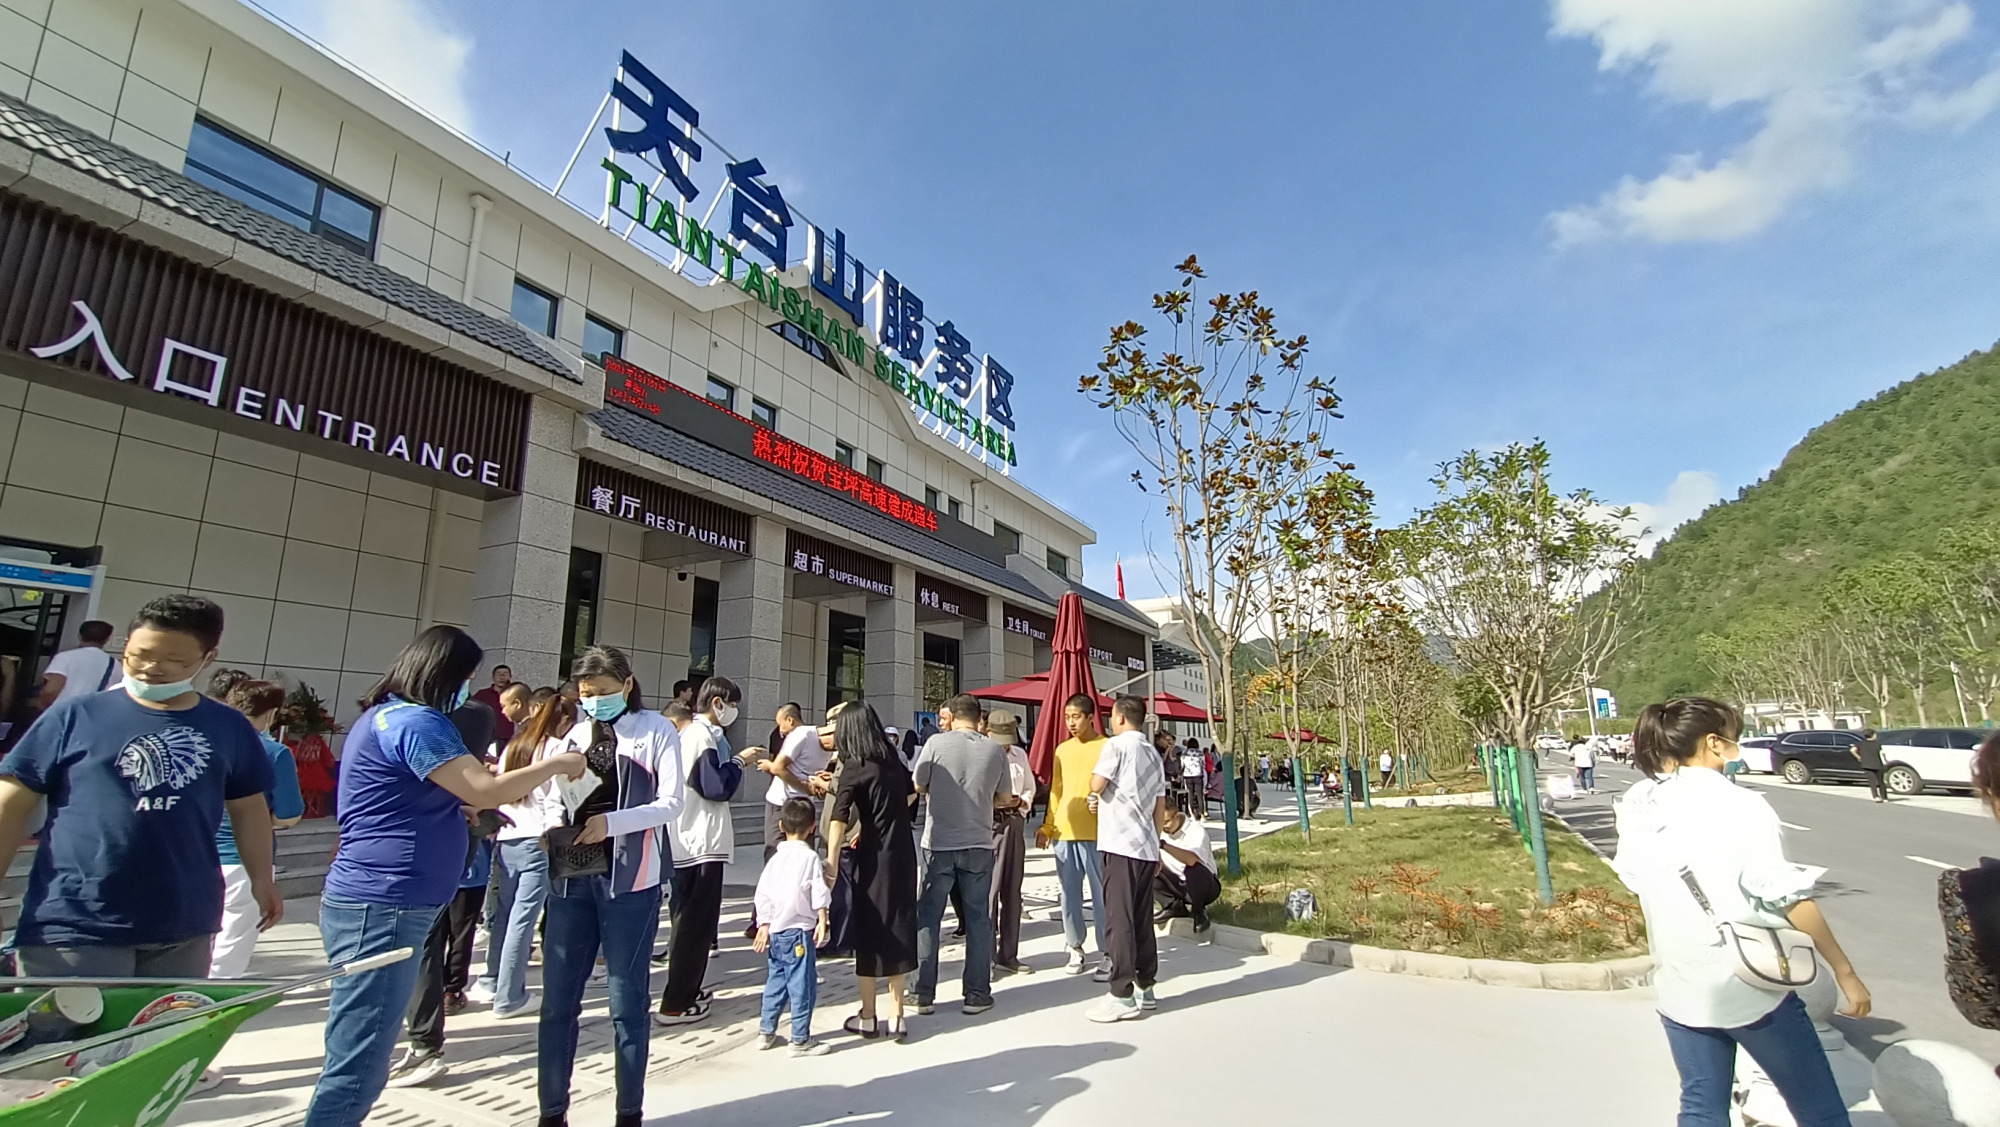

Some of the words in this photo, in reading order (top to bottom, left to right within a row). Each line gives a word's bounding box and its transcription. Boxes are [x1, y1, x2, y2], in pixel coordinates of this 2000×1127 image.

[603, 48, 1015, 431] 天台山服务区
[601, 158, 864, 367] TIANTAISHAN
[874, 351, 969, 436] SERVICE
[971, 417, 1017, 467] AREA
[30, 300, 227, 407] 入口
[235, 386, 501, 487] ENTRANCE
[753, 429, 938, 532] 热烈祝贺宝坪高速建成通车
[591, 485, 641, 519] 餐厅
[645, 513, 746, 552] RESTAURANT
[793, 549, 825, 576] 超市
[829, 567, 894, 596] SUPERMARKET
[920, 587, 939, 611] 休息
[942, 602, 960, 615] REST
[1029, 628, 1046, 641] TOILET
[1089, 647, 1113, 662] EXPORT
[136, 795, 181, 812] A&F
